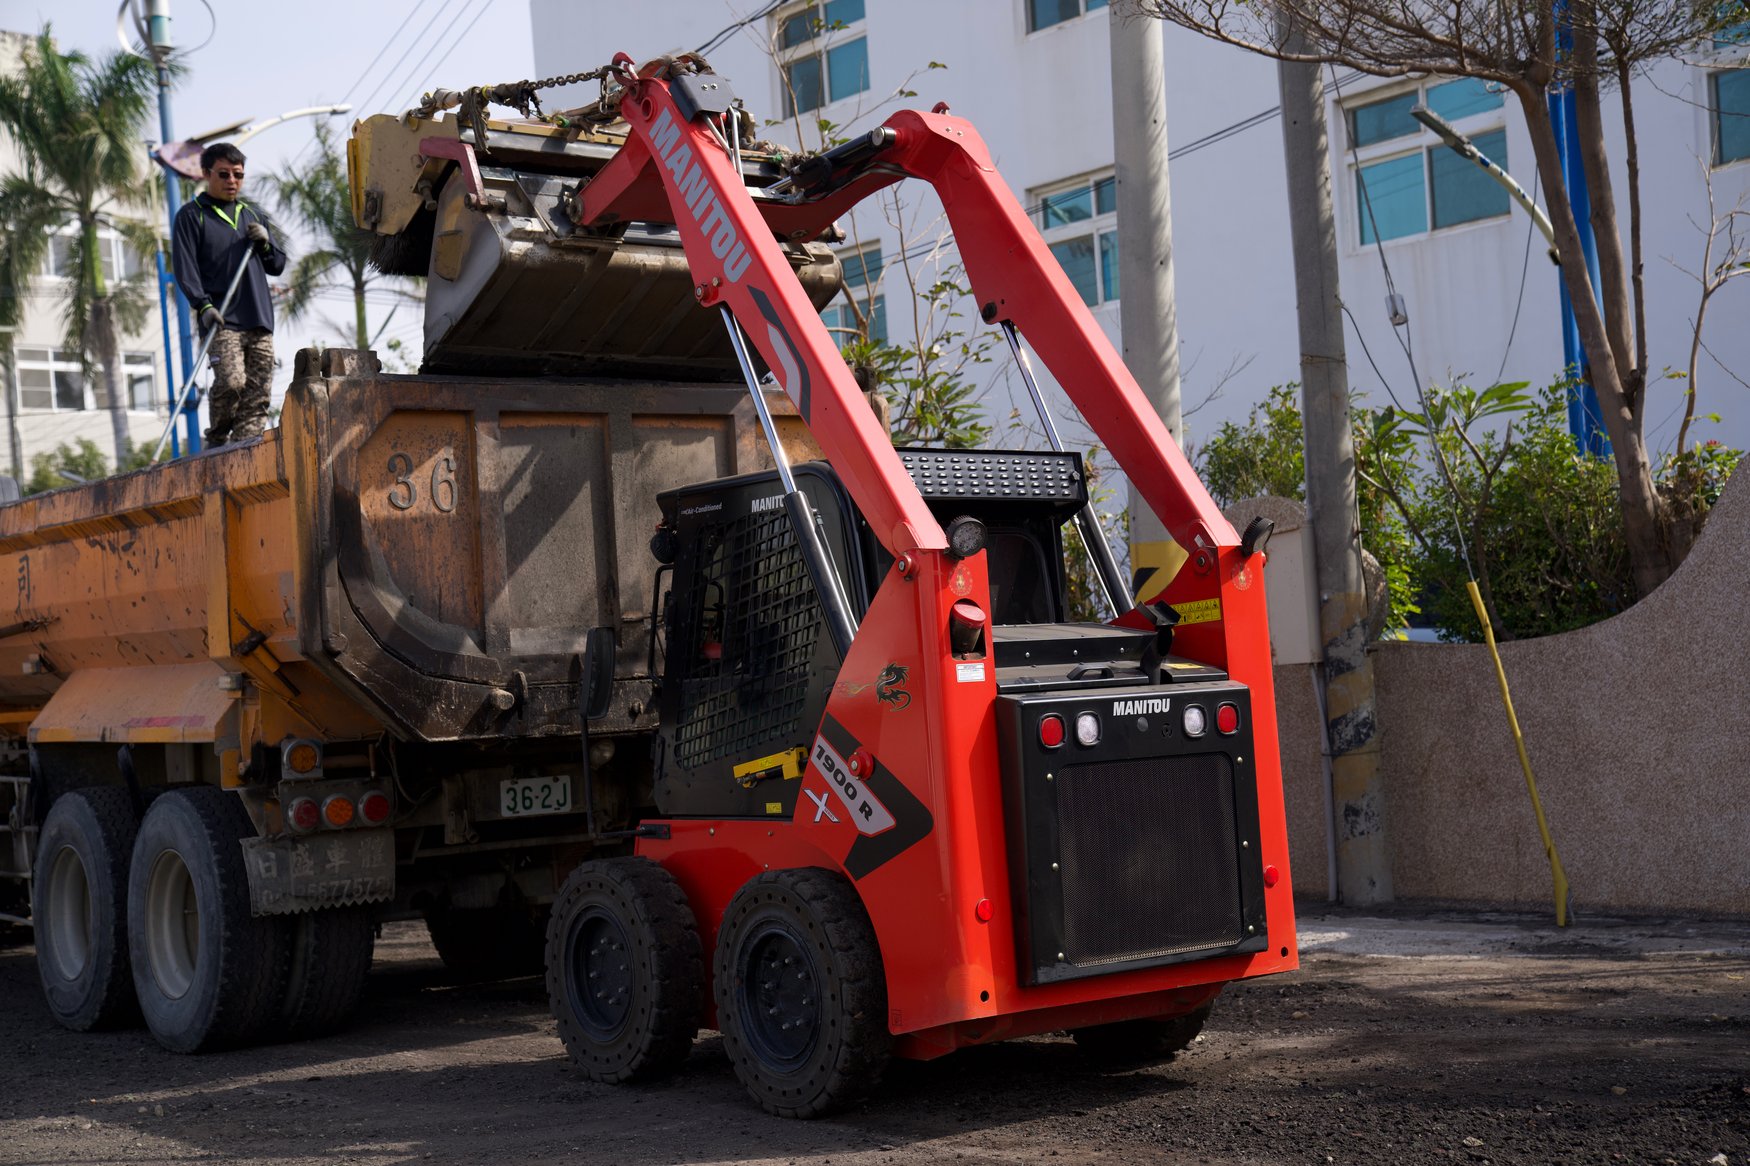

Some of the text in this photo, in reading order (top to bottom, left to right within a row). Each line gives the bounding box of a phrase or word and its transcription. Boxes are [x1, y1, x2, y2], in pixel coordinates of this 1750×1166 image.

[648, 106, 752, 284] MANITOU
[388, 451, 458, 512] 36
[1113, 698, 1171, 717] MANITOU
[816, 744, 858, 801] 1900
[859, 800, 873, 822] R
